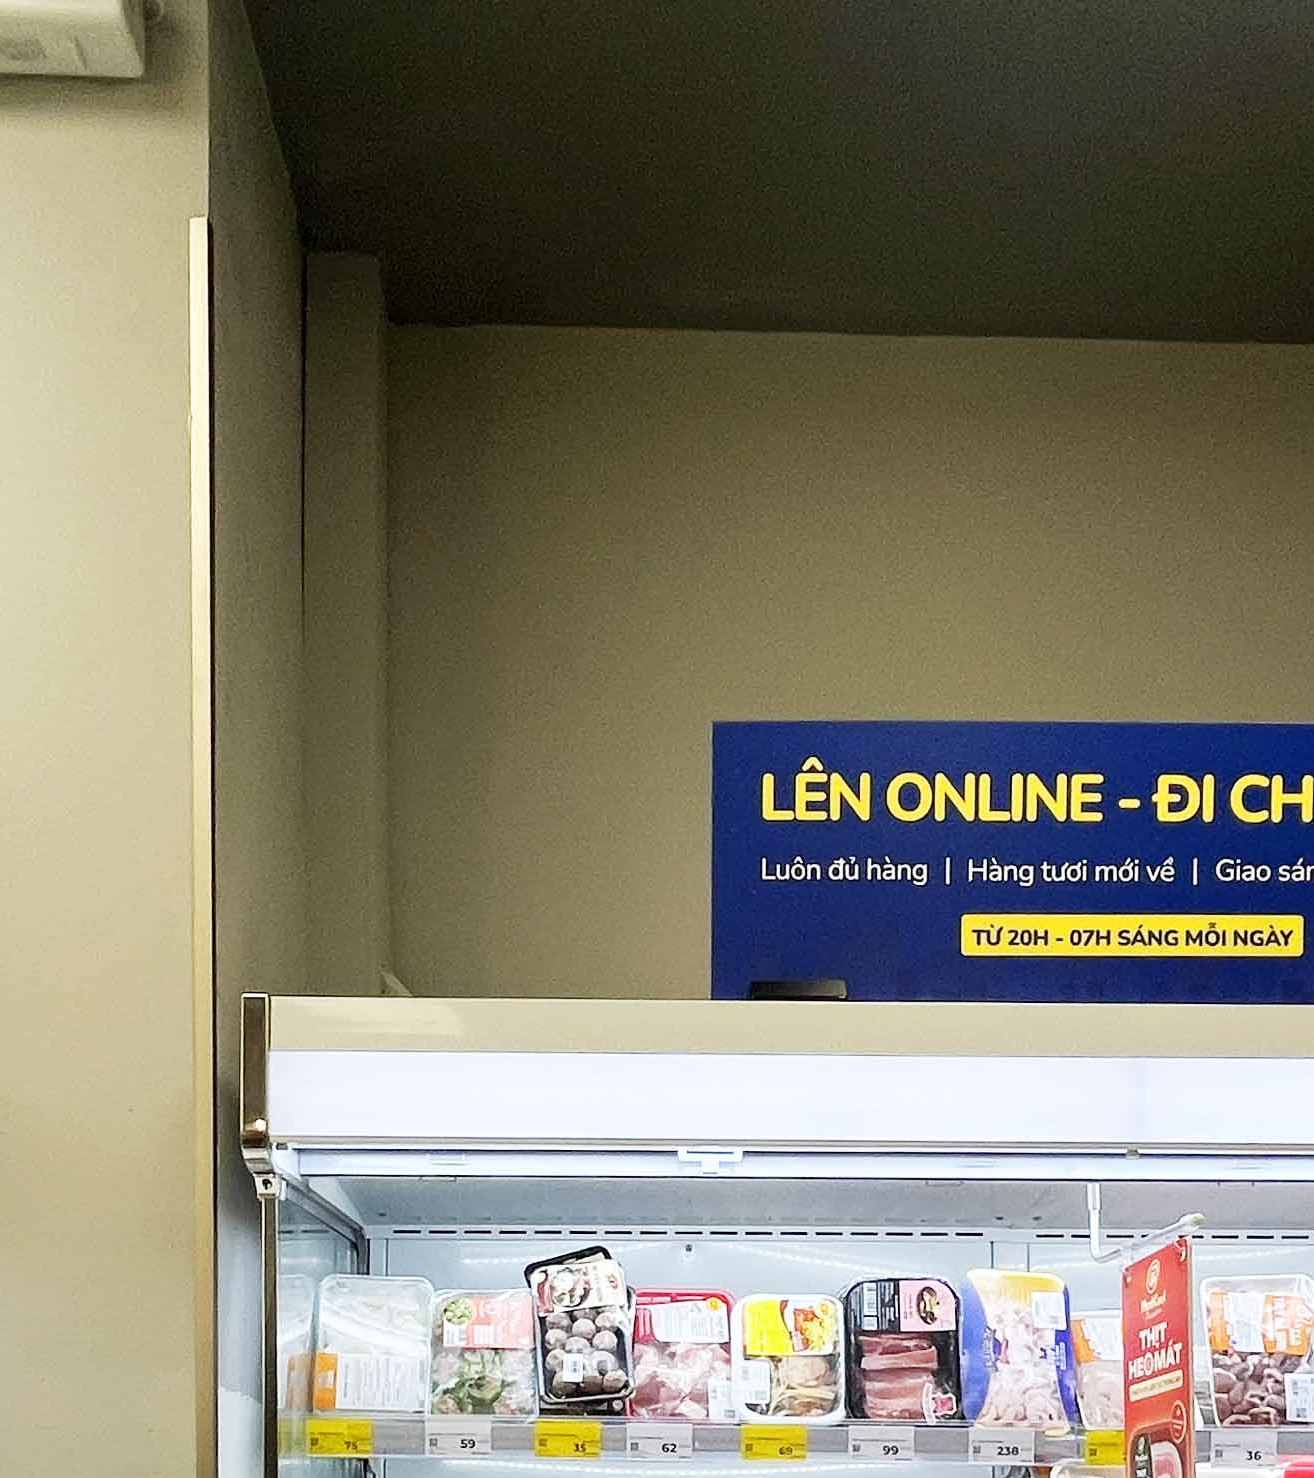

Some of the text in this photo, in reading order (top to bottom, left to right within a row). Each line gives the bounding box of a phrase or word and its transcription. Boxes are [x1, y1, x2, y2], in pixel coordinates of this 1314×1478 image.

[762, 758, 871, 820] LÊN
[887, 773, 1103, 822] ONLINE
[1154, 775, 1214, 821] ĐI
[762, 856, 820, 880] Luôn
[829, 857, 858, 880] đủ
[867, 856, 927, 885] hàng
[969, 858, 1034, 886] Hàng
[1041, 860, 1087, 881] tươi
[1095, 858, 1139, 881] mới
[1146, 857, 1175, 881] về
[1216, 859, 1271, 881] Giao
[972, 924, 1003, 946] TỪ
[1008, 929, 1048, 946] 20H
[1070, 930, 1111, 946] 07H
[1118, 925, 1178, 946] SÁNG
[1185, 923, 1226, 946] MỖI
[1234, 925, 1293, 946] NGÀY
[1139, 1322, 1167, 1350] THỊT
[460, 1437, 476, 1449] 59
[661, 1442, 678, 1453] 62
[882, 1445, 900, 1455] 99
[1246, 1450, 1262, 1461] 36
